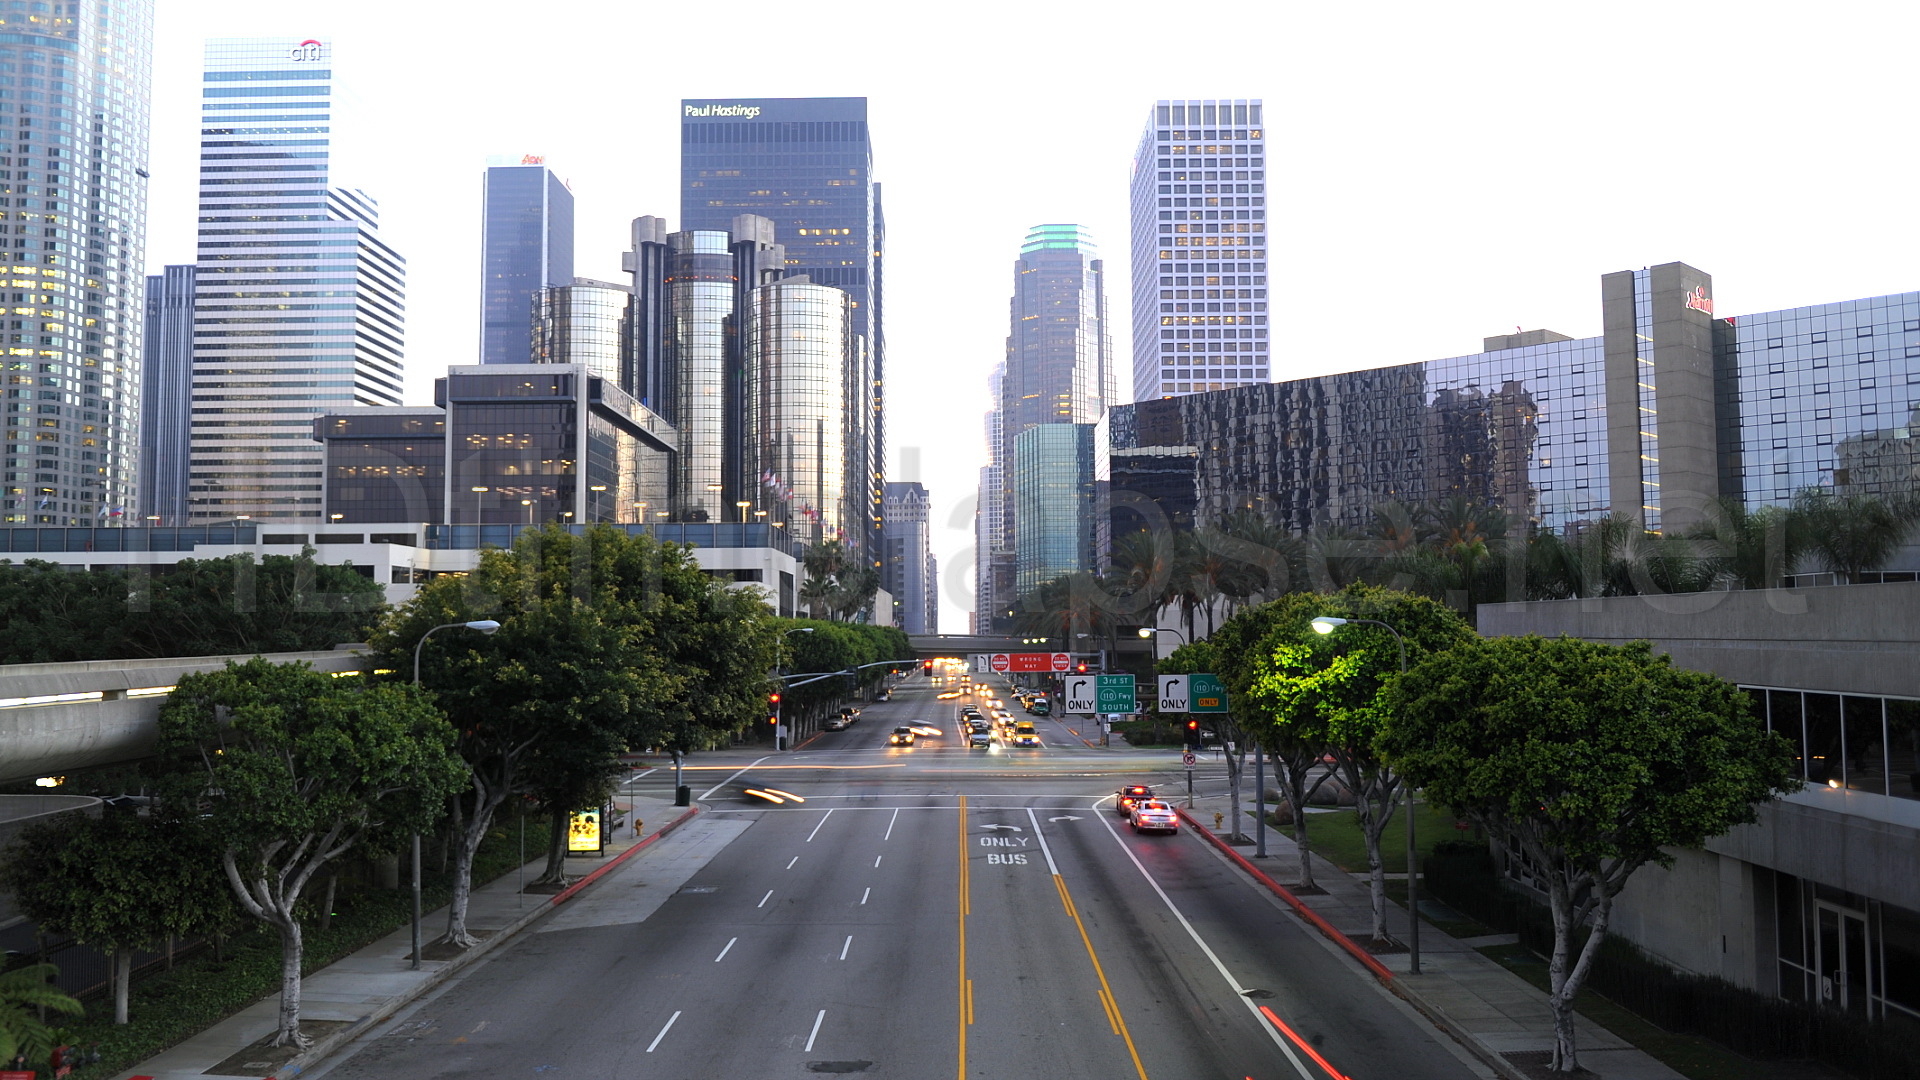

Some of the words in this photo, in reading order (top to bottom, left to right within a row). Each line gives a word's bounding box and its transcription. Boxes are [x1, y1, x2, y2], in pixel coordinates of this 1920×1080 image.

[291, 41, 321, 61] citi
[685, 105, 710, 116] Paul
[711, 104, 760, 119] Hastings
[1069, 700, 1094, 710] ONLY
[1161, 699, 1187, 709] ONLY
[980, 837, 1029, 847] ONLY
[987, 853, 1028, 865] BUS
